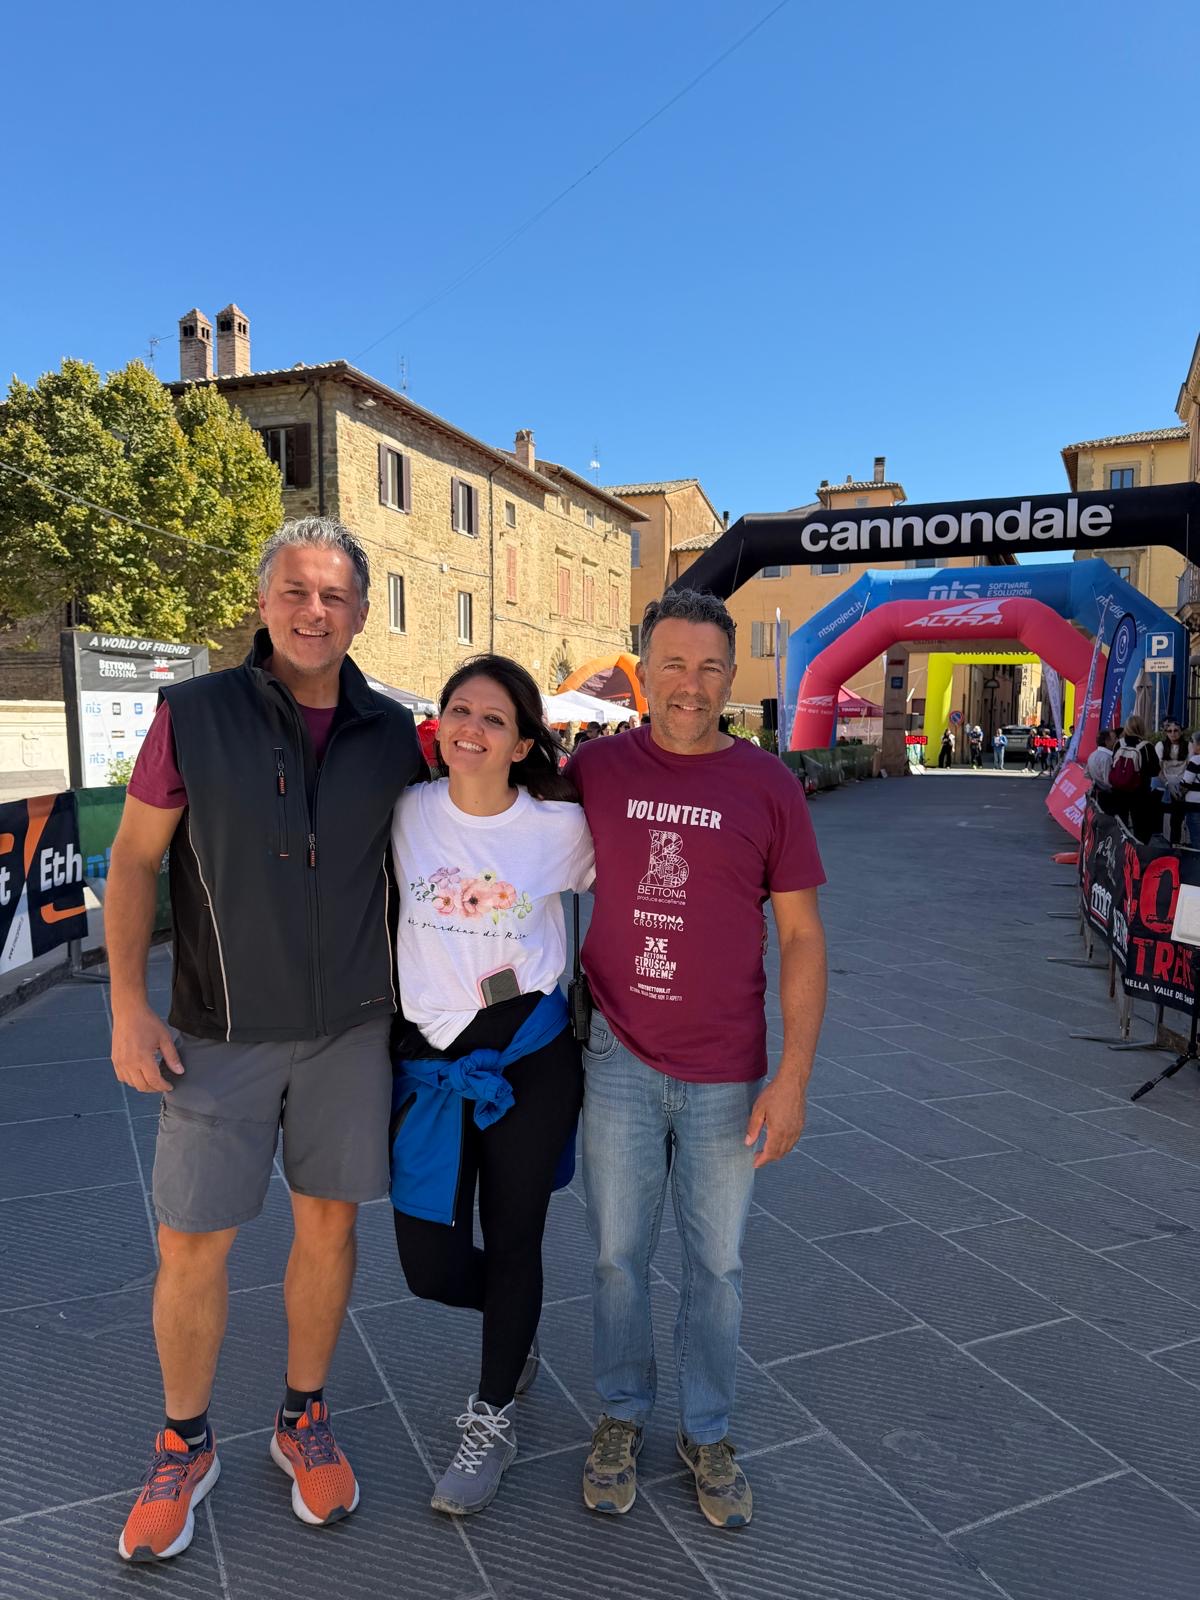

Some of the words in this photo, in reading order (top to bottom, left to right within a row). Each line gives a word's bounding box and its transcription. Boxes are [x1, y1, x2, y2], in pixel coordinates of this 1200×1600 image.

[801, 498, 1112, 552] cannondale
[988, 582, 1031, 591] SOFTWARE
[817, 601, 863, 638] ntsproject.it
[904, 615, 1003, 628] ALTRA
[89, 636, 98, 646] A
[101, 637, 138, 650] WORLD
[138, 641, 153, 651] OF
[153, 643, 191, 656] FRIENDS
[1151, 635, 1169, 657] P
[99, 660, 136, 670] BETTONA
[100, 669, 137, 679] CROSSING
[626, 799, 722, 830] VOLUNTEER
[41, 843, 83, 892] Eth
[637, 885, 687, 900] BETTONA
[633, 917, 684, 932] CROSSING
[634, 909, 684, 924] BETTONA
[635, 955, 677, 972] ETRUSCAN
[636, 965, 674, 980] EXTREME
[1125, 978, 1150, 992] NELLA
[1153, 985, 1174, 998] VALLE
